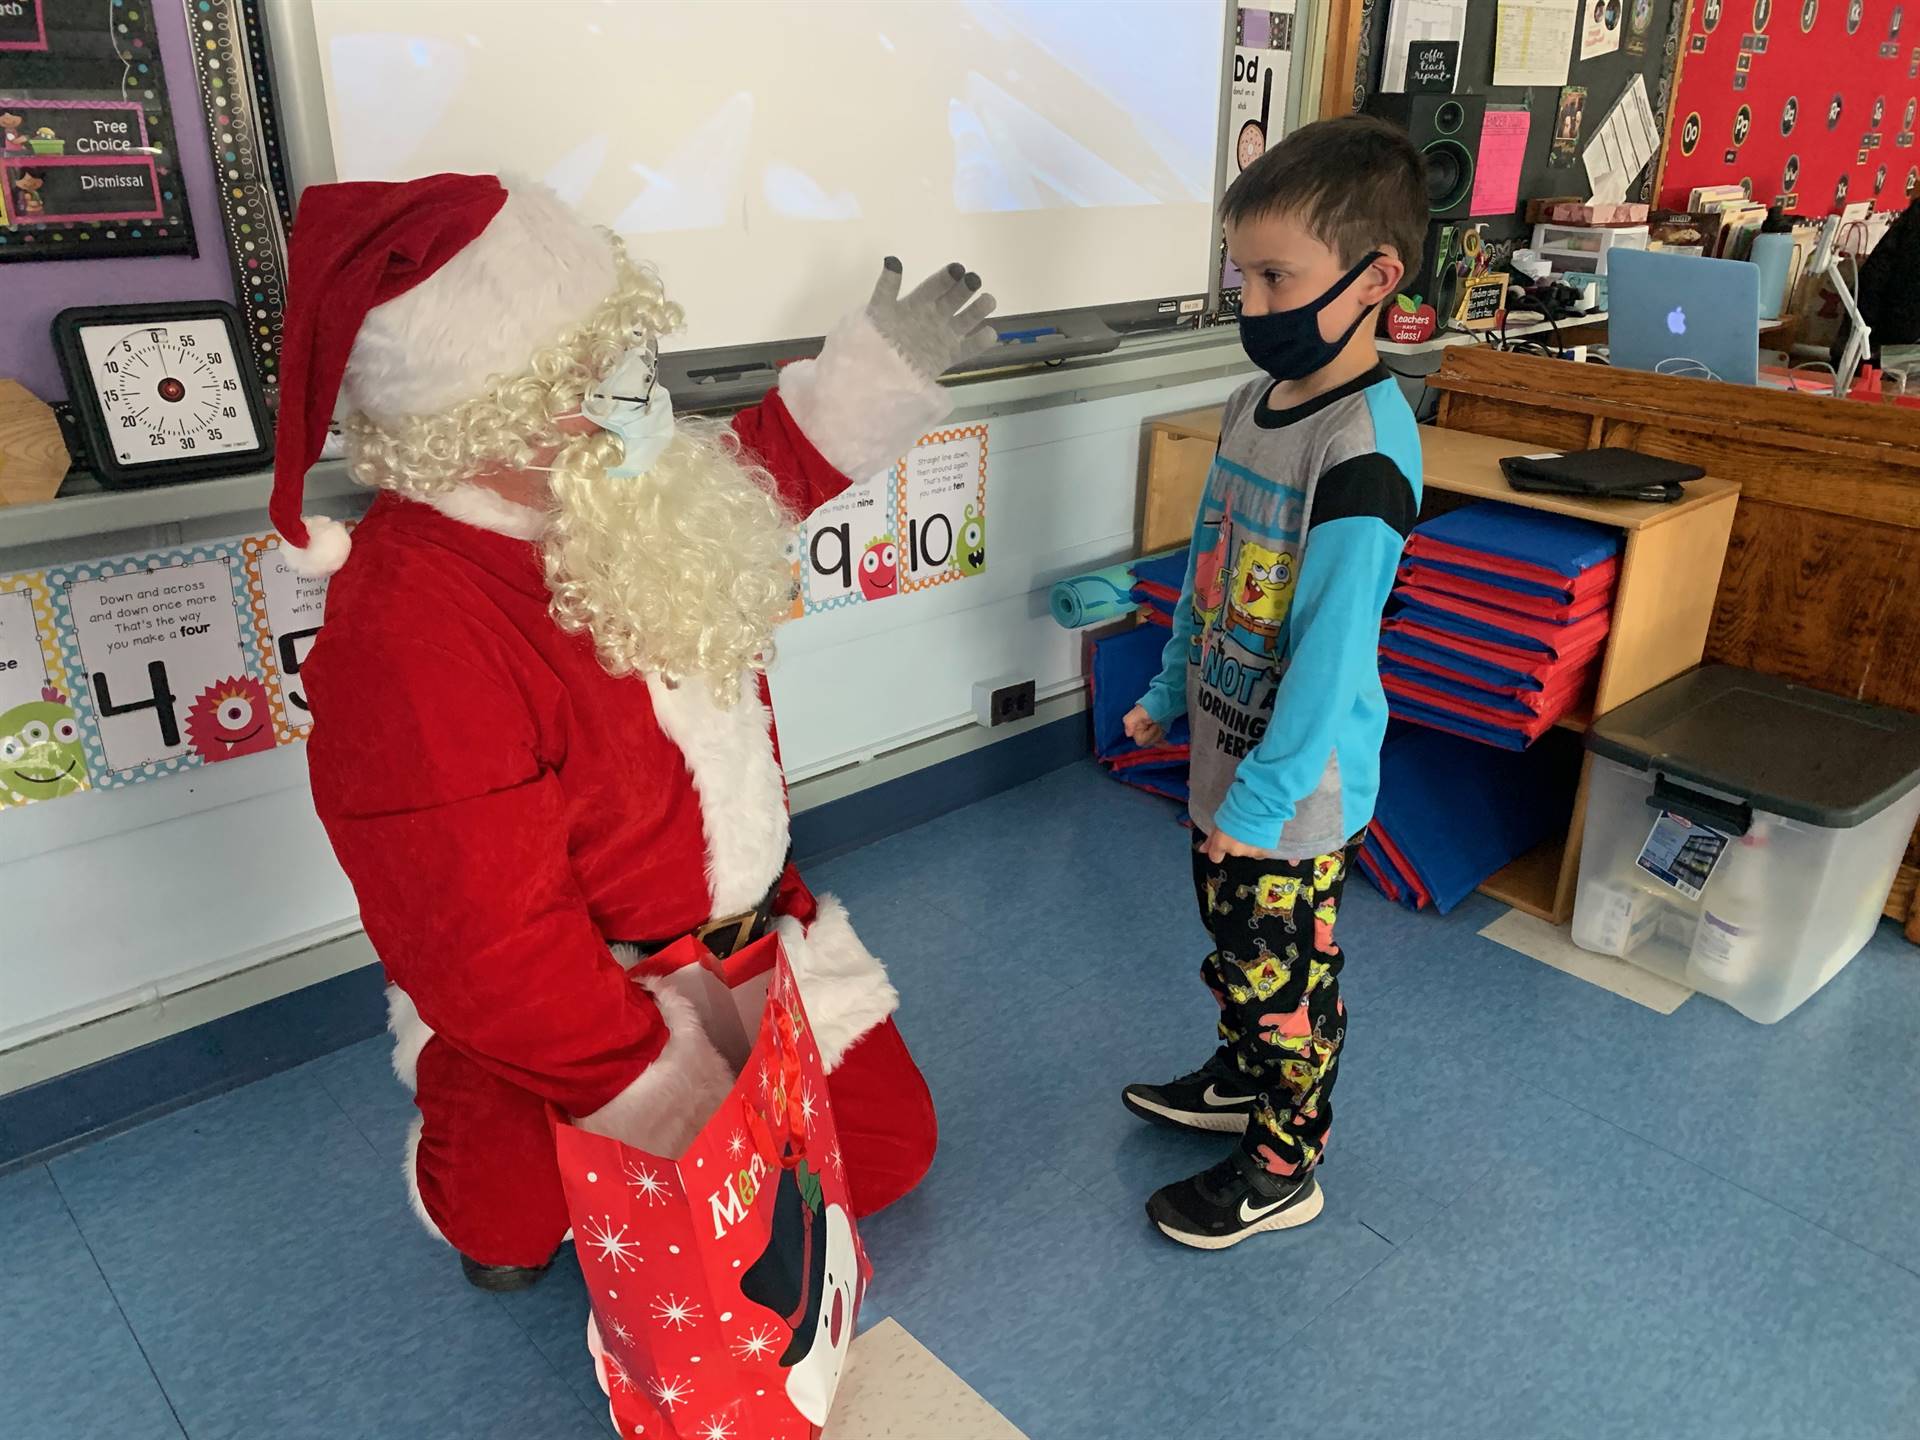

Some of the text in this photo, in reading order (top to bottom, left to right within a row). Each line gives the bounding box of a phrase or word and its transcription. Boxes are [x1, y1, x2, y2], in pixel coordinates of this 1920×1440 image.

[1234, 54, 1259, 83] Dd
[1419, 60, 1446, 71] teach
[93, 120, 128, 135] Free
[1684, 122, 1698, 142] Oo
[1735, 115, 1749, 138] Pp
[76, 138, 131, 152] Choice
[81, 175, 144, 190] Dismissal
[1393, 314, 1430, 324] teachers
[151, 332, 160, 344] 0
[179, 334, 196, 348] 55
[1396, 330, 1422, 341] class!
[123, 340, 132, 353] 5
[207, 352, 222, 365] 50
[104, 361, 119, 374] 10
[223, 379, 237, 392] 45
[103, 390, 119, 402] 15
[222, 406, 237, 418] 40
[121, 415, 137, 428] 20
[149, 433, 166, 446] 25
[207, 428, 223, 441] 35
[179, 437, 196, 450] 30
[953, 481, 965, 491] ten
[857, 498, 874, 508] nine
[909, 513, 953, 572] 10
[810, 523, 851, 588] 9
[100, 582, 205, 606] Down and across
[295, 585, 326, 600] Finish
[89, 595, 217, 623] and down once more
[291, 602, 322, 615] with a
[114, 611, 201, 634] That's the way
[106, 623, 211, 655] you make a four
[1203, 645, 1265, 706] NOT
[93, 660, 181, 747] 4
[1199, 686, 1268, 739] ORNING
